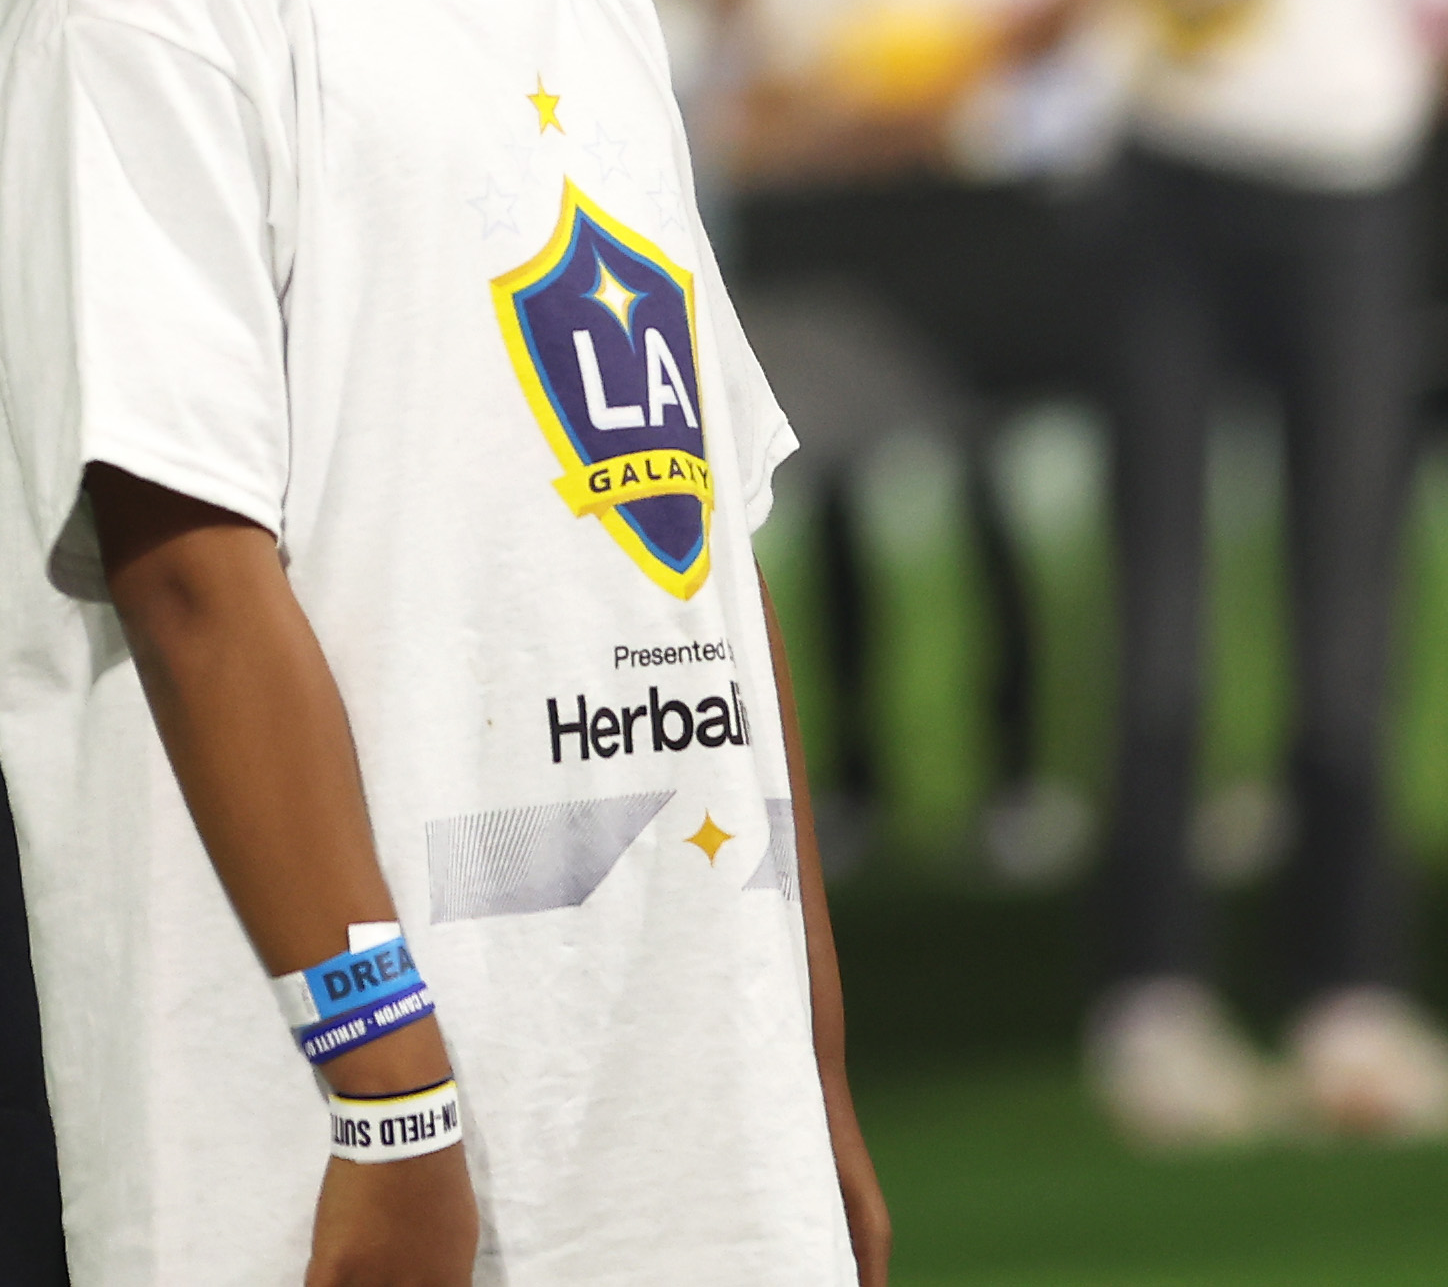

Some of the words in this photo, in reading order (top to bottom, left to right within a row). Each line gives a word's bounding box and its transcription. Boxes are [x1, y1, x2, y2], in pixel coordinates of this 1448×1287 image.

[571, 326, 700, 431] LA
[614, 638, 726, 669] Presented
[373, 992, 423, 1027] CANYON
[331, 1111, 372, 1149] SUIT
